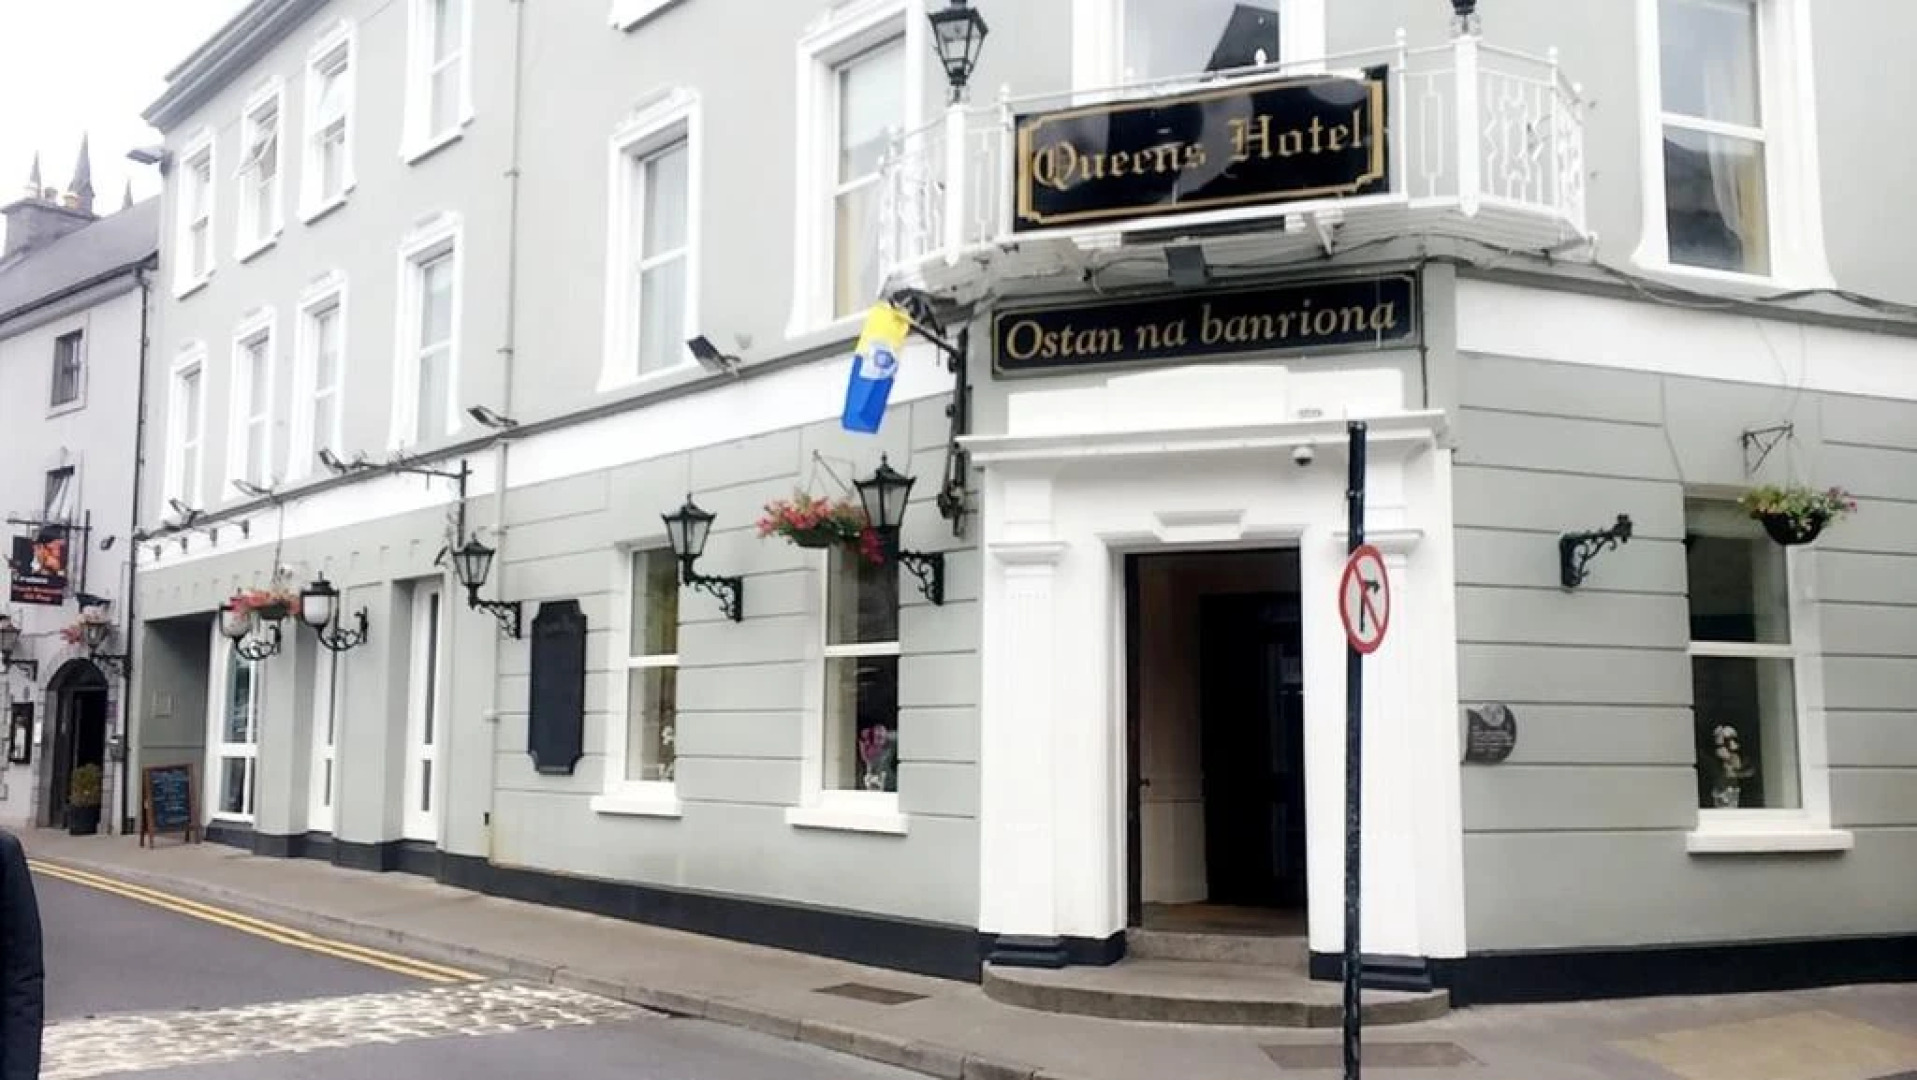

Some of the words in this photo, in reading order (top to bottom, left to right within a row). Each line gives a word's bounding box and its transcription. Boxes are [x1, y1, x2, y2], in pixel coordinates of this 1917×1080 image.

[1034, 140, 1206, 191] Queens
[1227, 108, 1362, 162] Hotel
[1006, 319, 1124, 360] Ostan
[1135, 319, 1187, 350] na
[1201, 299, 1397, 344] banriona
